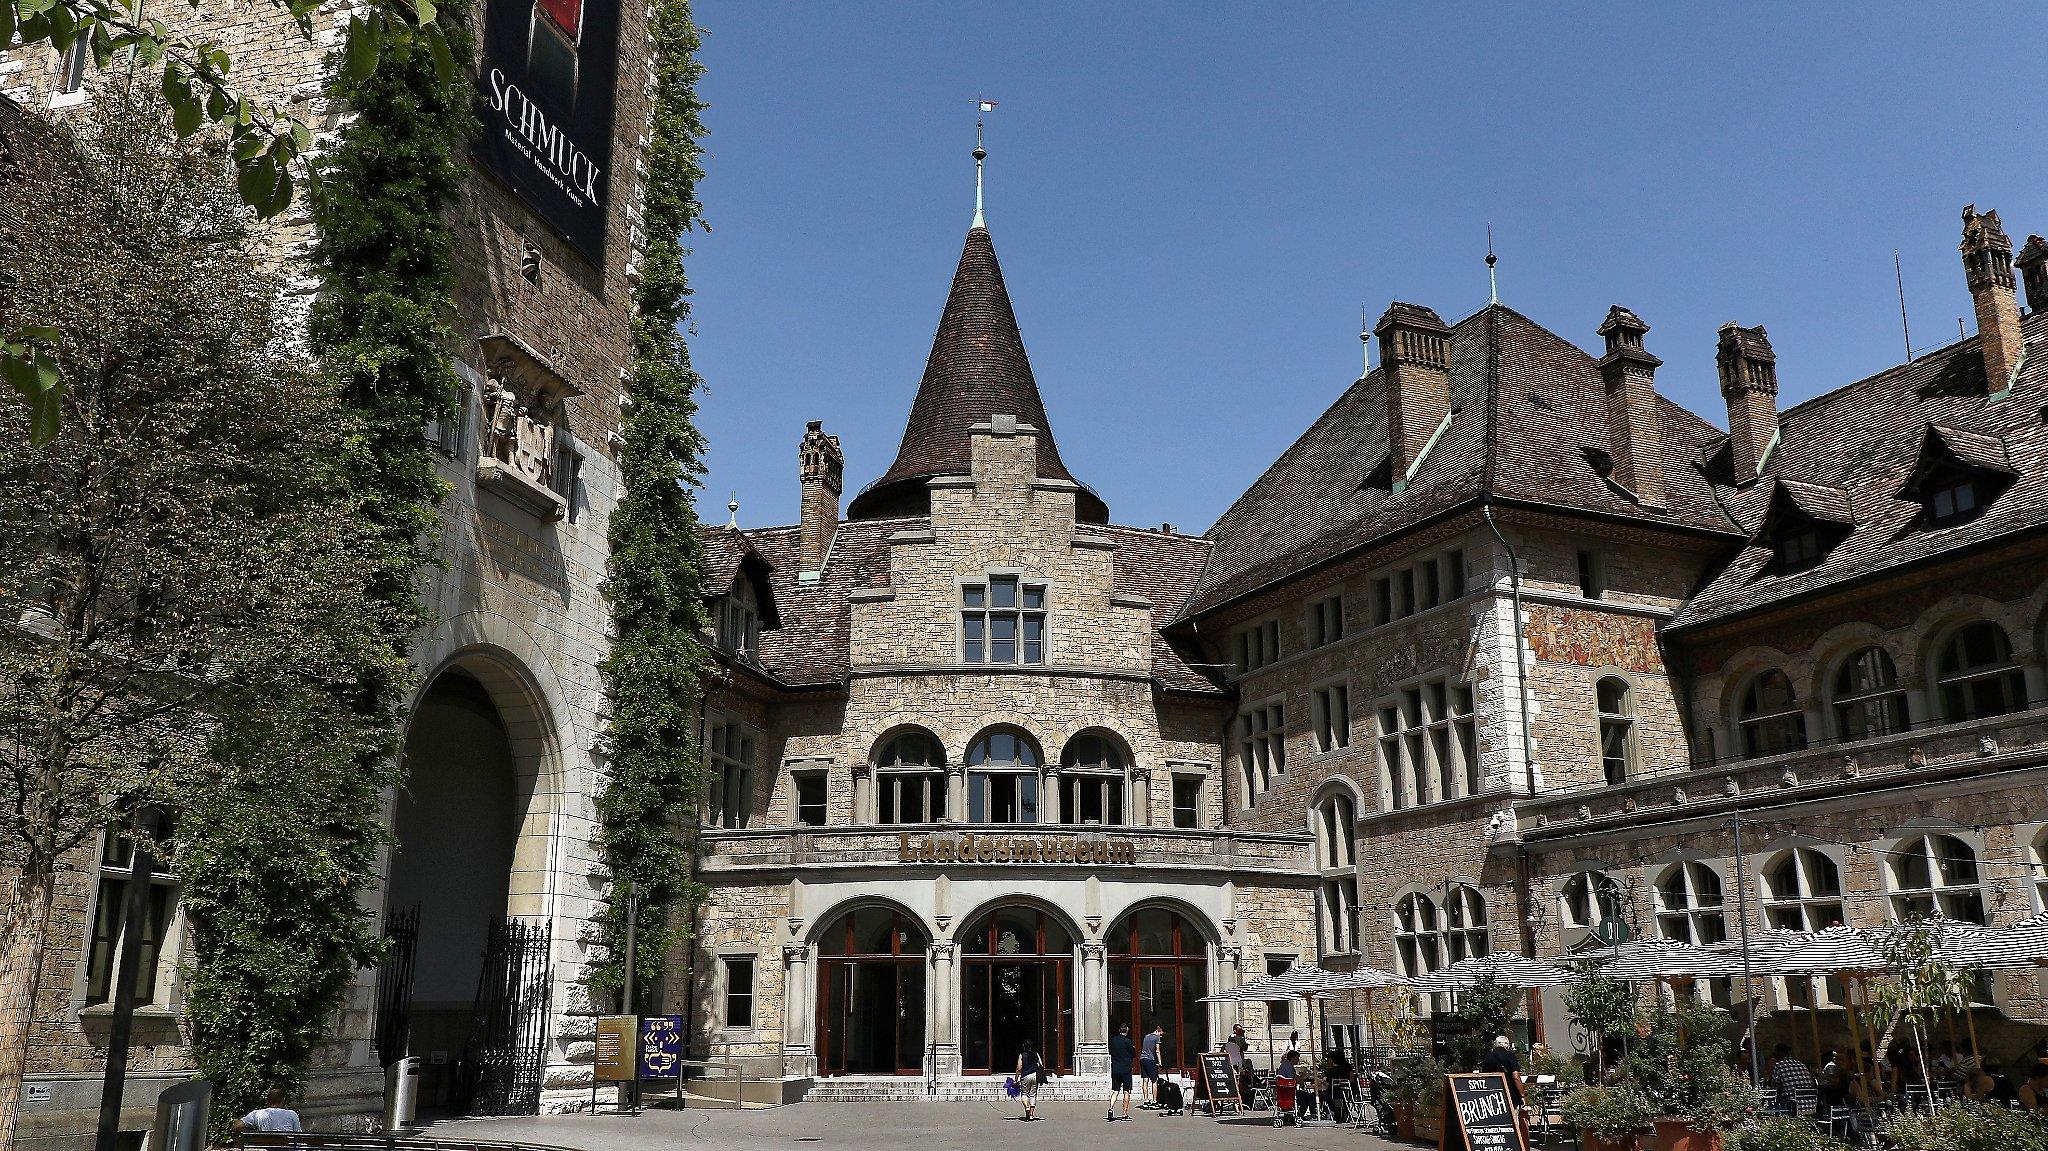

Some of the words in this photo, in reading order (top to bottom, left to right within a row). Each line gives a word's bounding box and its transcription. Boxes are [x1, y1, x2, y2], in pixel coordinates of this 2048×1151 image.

[490, 68, 600, 207] SCHMUCK
[505, 128, 532, 160] Material
[534, 155, 564, 190] Handwerk
[899, 833, 1136, 863] Landesmuseum
[1460, 1091, 1508, 1125] BRUNCH
